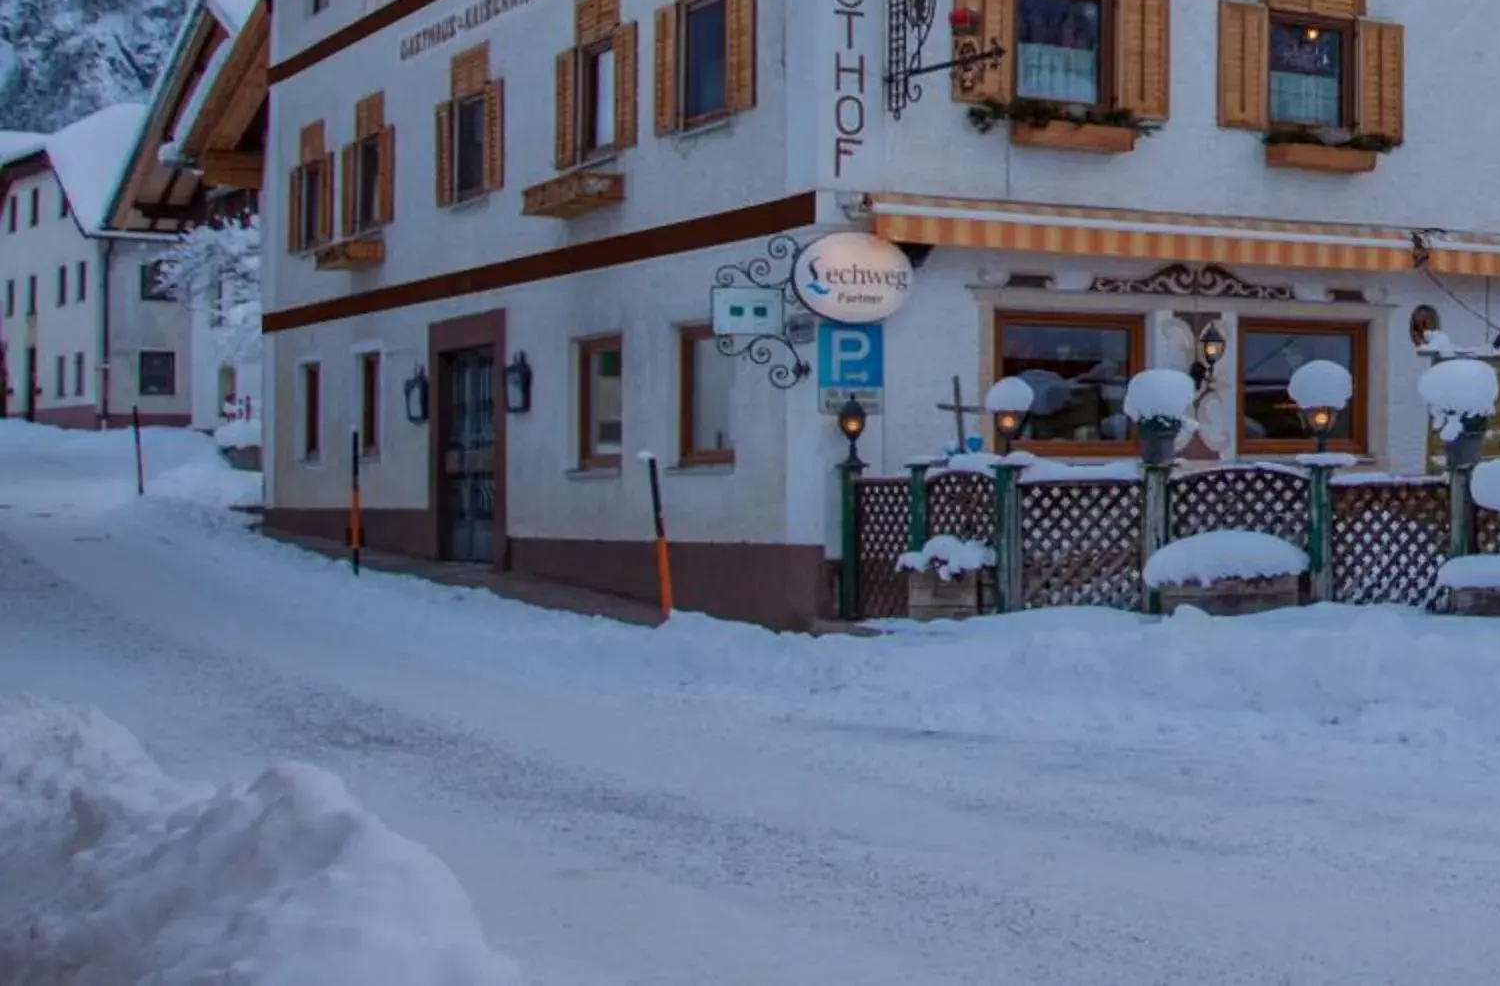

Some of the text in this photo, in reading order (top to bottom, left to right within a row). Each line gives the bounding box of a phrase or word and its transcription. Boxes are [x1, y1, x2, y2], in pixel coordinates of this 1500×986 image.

[806, 256, 908, 295] Lechweg
[837, 293, 884, 305] Partner
[831, 330, 870, 382] P
